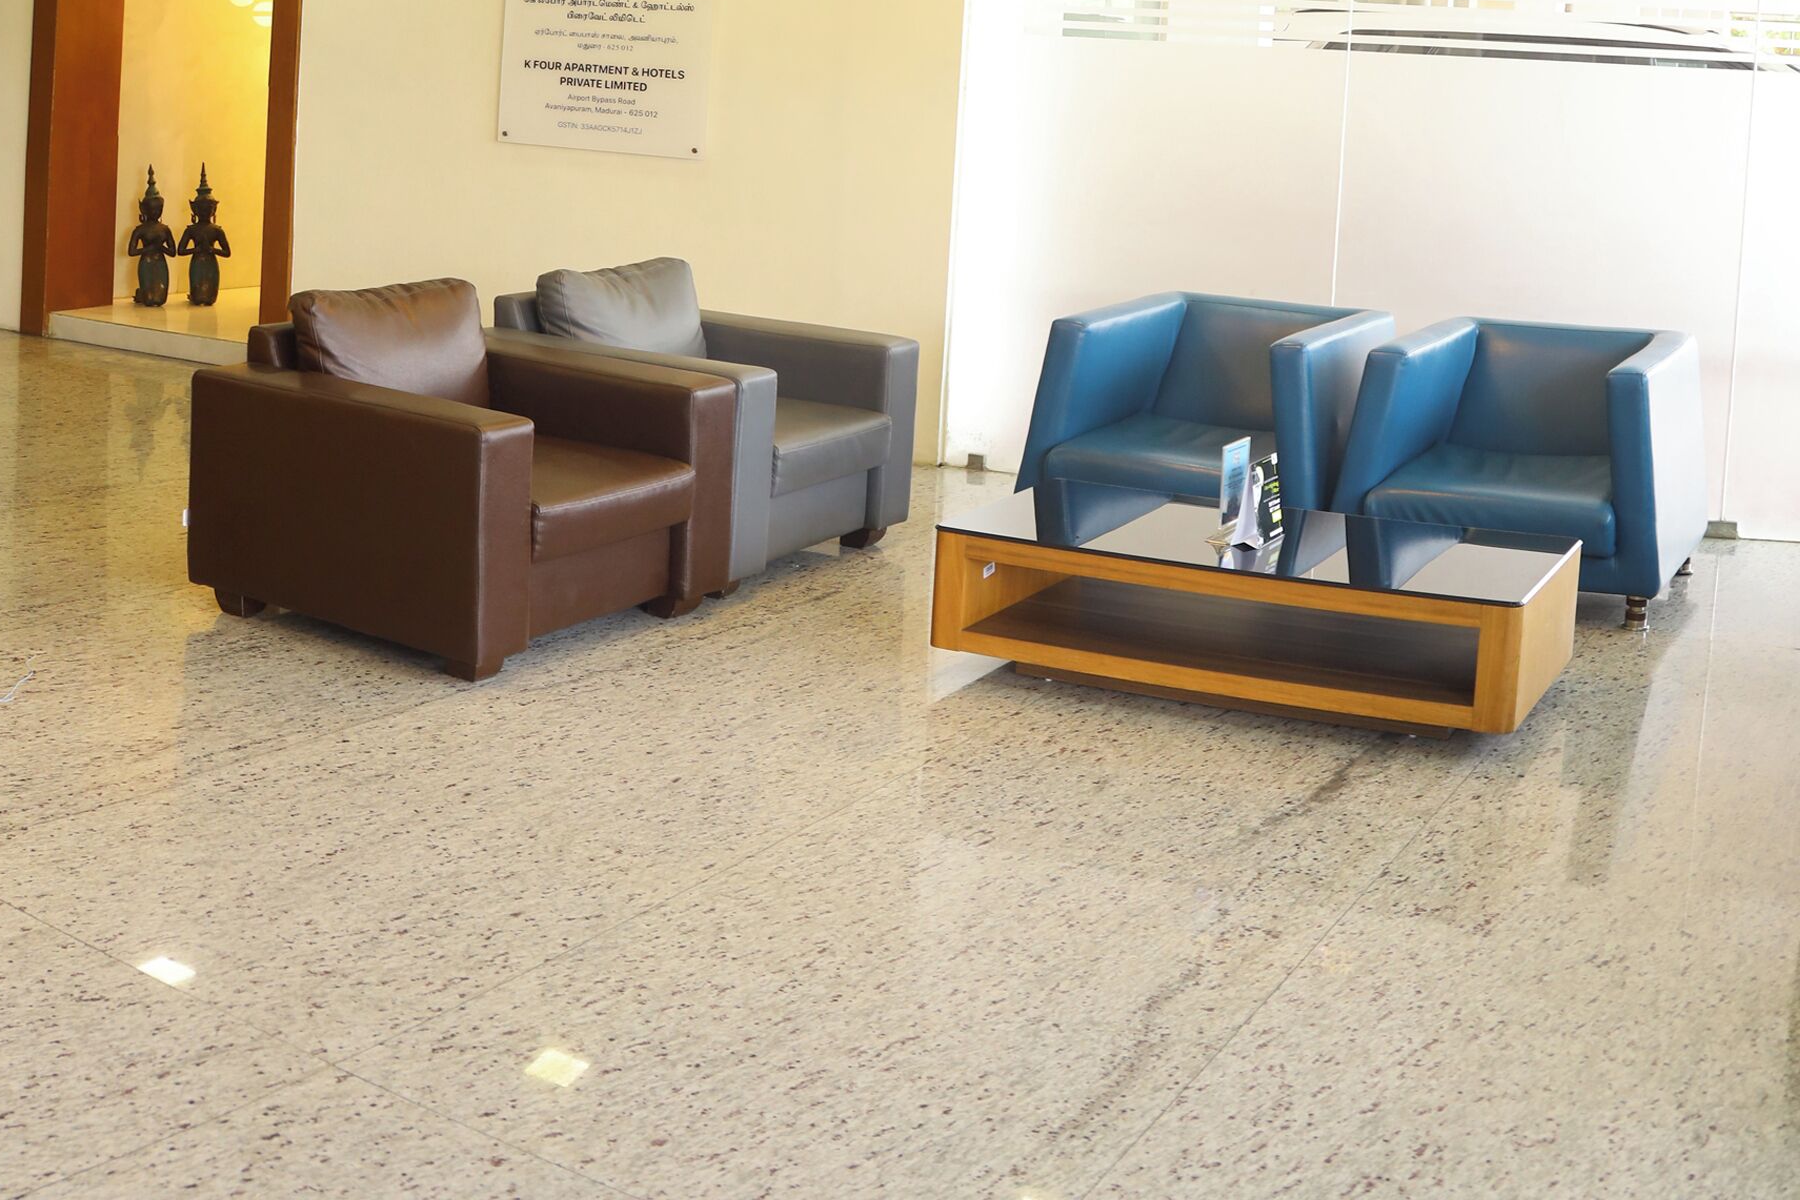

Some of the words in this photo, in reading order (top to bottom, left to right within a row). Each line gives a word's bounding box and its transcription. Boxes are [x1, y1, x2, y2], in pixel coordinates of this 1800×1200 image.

[524, 60, 531, 69] K
[533, 60, 562, 71] FOUR
[564, 62, 630, 76] APARTMENT
[631, 67, 639, 76] &
[641, 68, 685, 80] HOTELS
[560, 76, 602, 88] PRIVATE
[604, 80, 648, 92] LIMITED
[567, 93, 591, 103] Airport
[591, 95, 617, 105] Bypass
[618, 97, 636, 106] Road
[544, 102, 594, 113] Avaniyapuram,
[595, 106, 623, 115] Madurai
